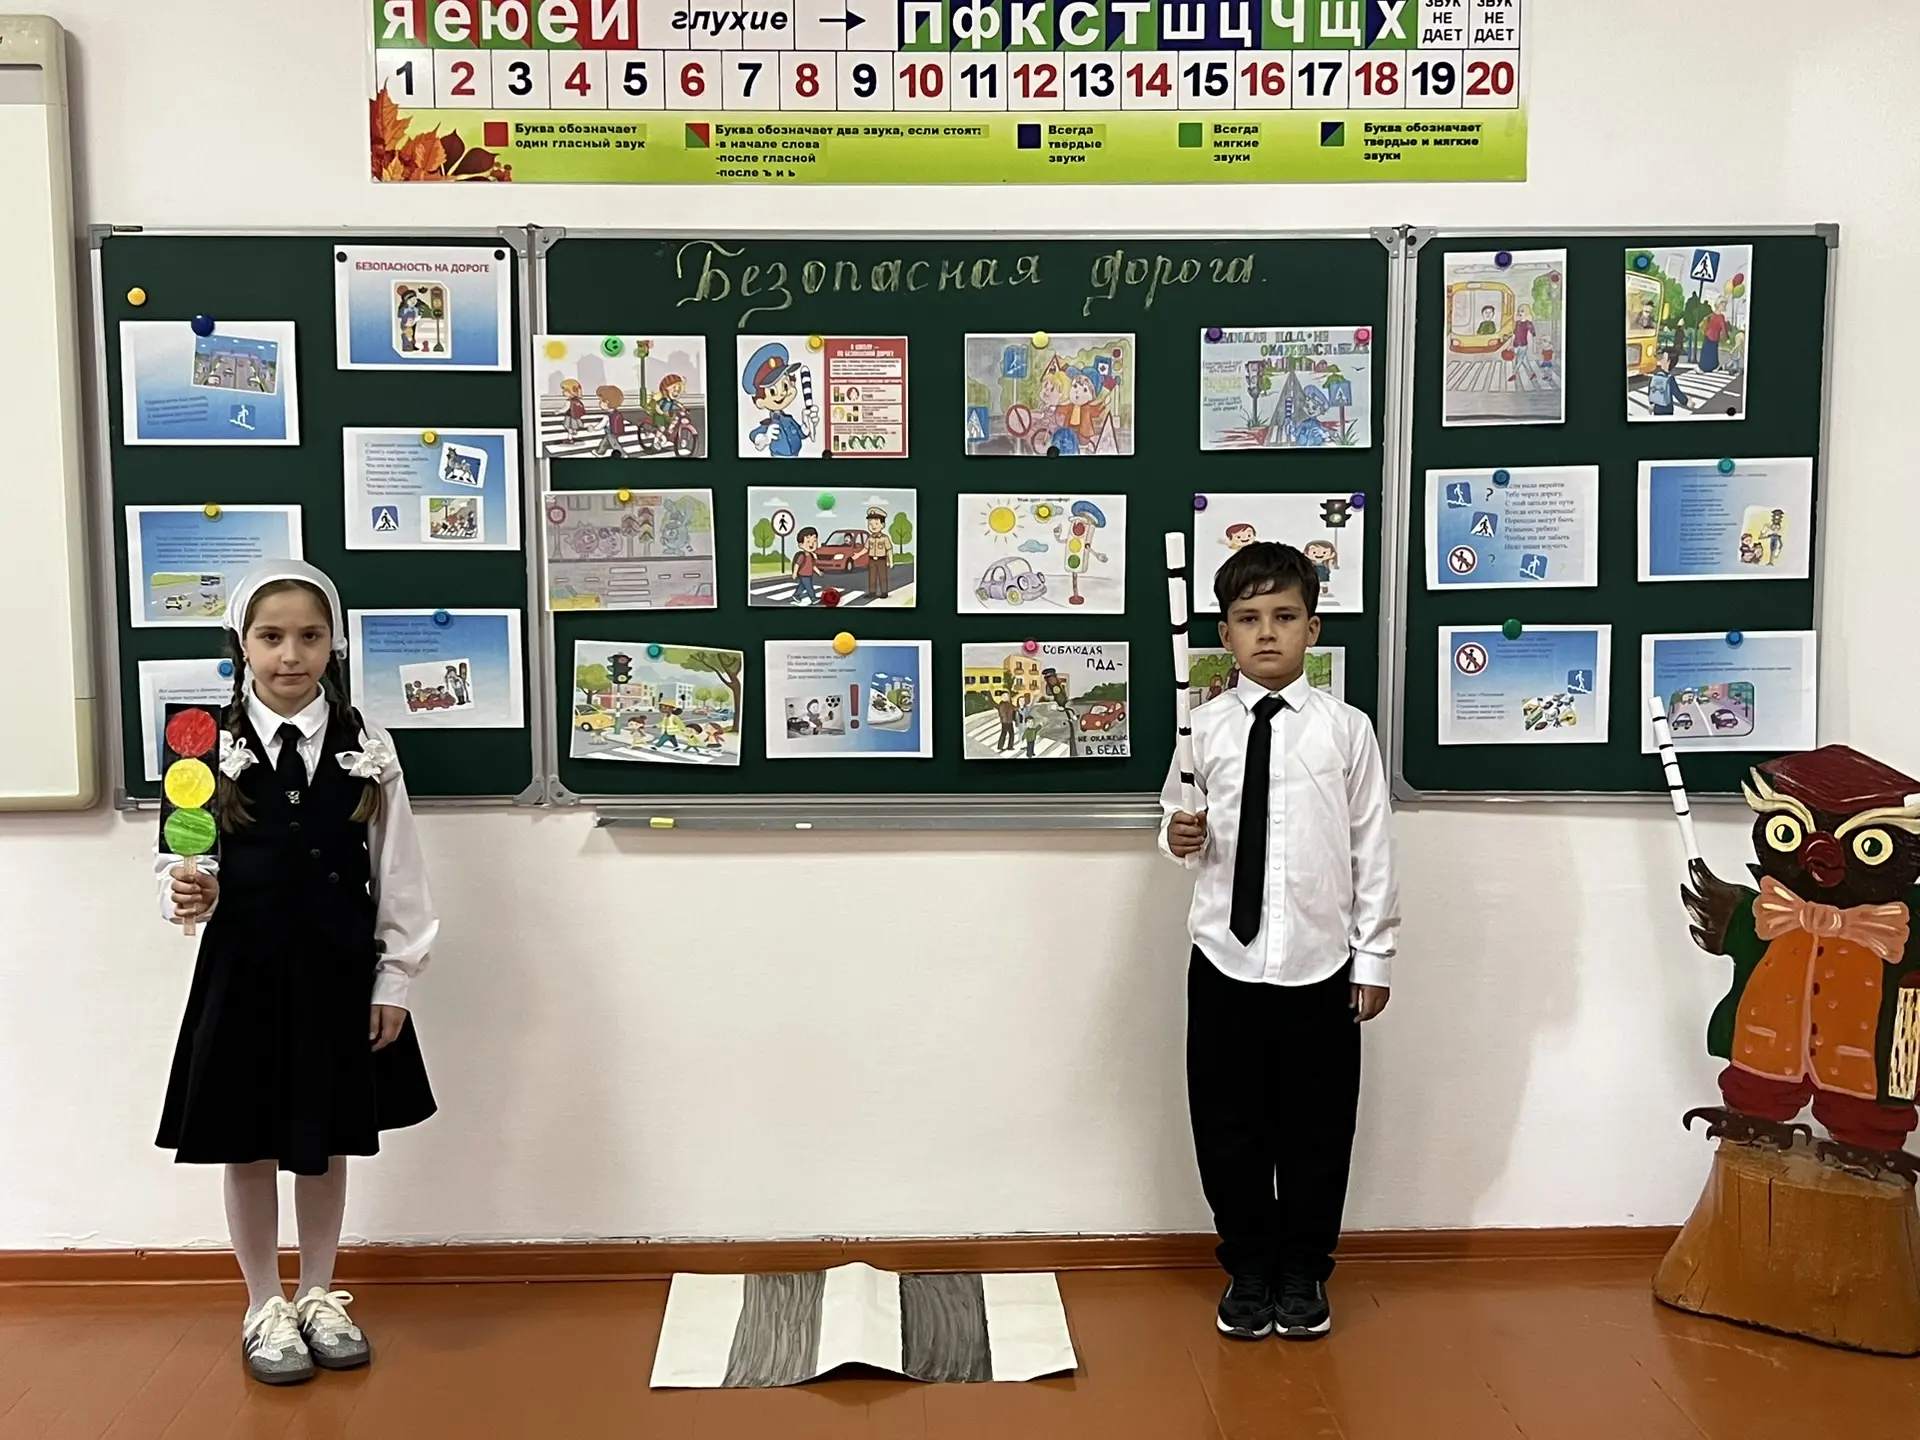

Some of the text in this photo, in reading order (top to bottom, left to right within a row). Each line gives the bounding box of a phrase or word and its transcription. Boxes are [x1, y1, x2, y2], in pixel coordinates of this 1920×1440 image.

[671, 11, 788, 36] глухие
[1433, 12, 1453, 24] НЕ
[1484, 12, 1505, 24] НЕ
[1422, 28, 1463, 44] ДАЕТ
[1474, 28, 1515, 43] ДАЕТ
[397, 62, 1514, 98] 1 2 3 4 5 6 7 8 9 10 11 12 13 14 15 16 17 18 19 20
[515, 123, 637, 135] Буква обозначает
[715, 124, 981, 137] Буква обозначает два звука, если стоят:
[1048, 125, 1094, 136] Всегда
[1213, 124, 1259, 135] Всегда
[1364, 122, 1482, 135] Буква обозначает
[515, 138, 645, 150] один гласный звук
[715, 140, 820, 149] -в начале слова
[1213, 140, 1259, 148] мягкие
[1421, 138, 1429, 146] и
[1433, 138, 1479, 146] мягкие
[716, 153, 816, 163] -после гласной
[1048, 155, 1085, 164] звуки
[1213, 154, 1250, 164] звуки
[1364, 152, 1401, 163] звуки
[716, 169, 759, 177] -после
[776, 169, 784, 177] и
[788, 169, 796, 177] ь
[355, 261, 490, 274] БЕЗОПАСНОСТЬ НА ДОРОГЕ
[676, 239, 1043, 328] Безопасная
[1043, 644, 1103, 655] СОБЛЮДАЯ
[1085, 744, 1127, 755] В БЕДЕ
